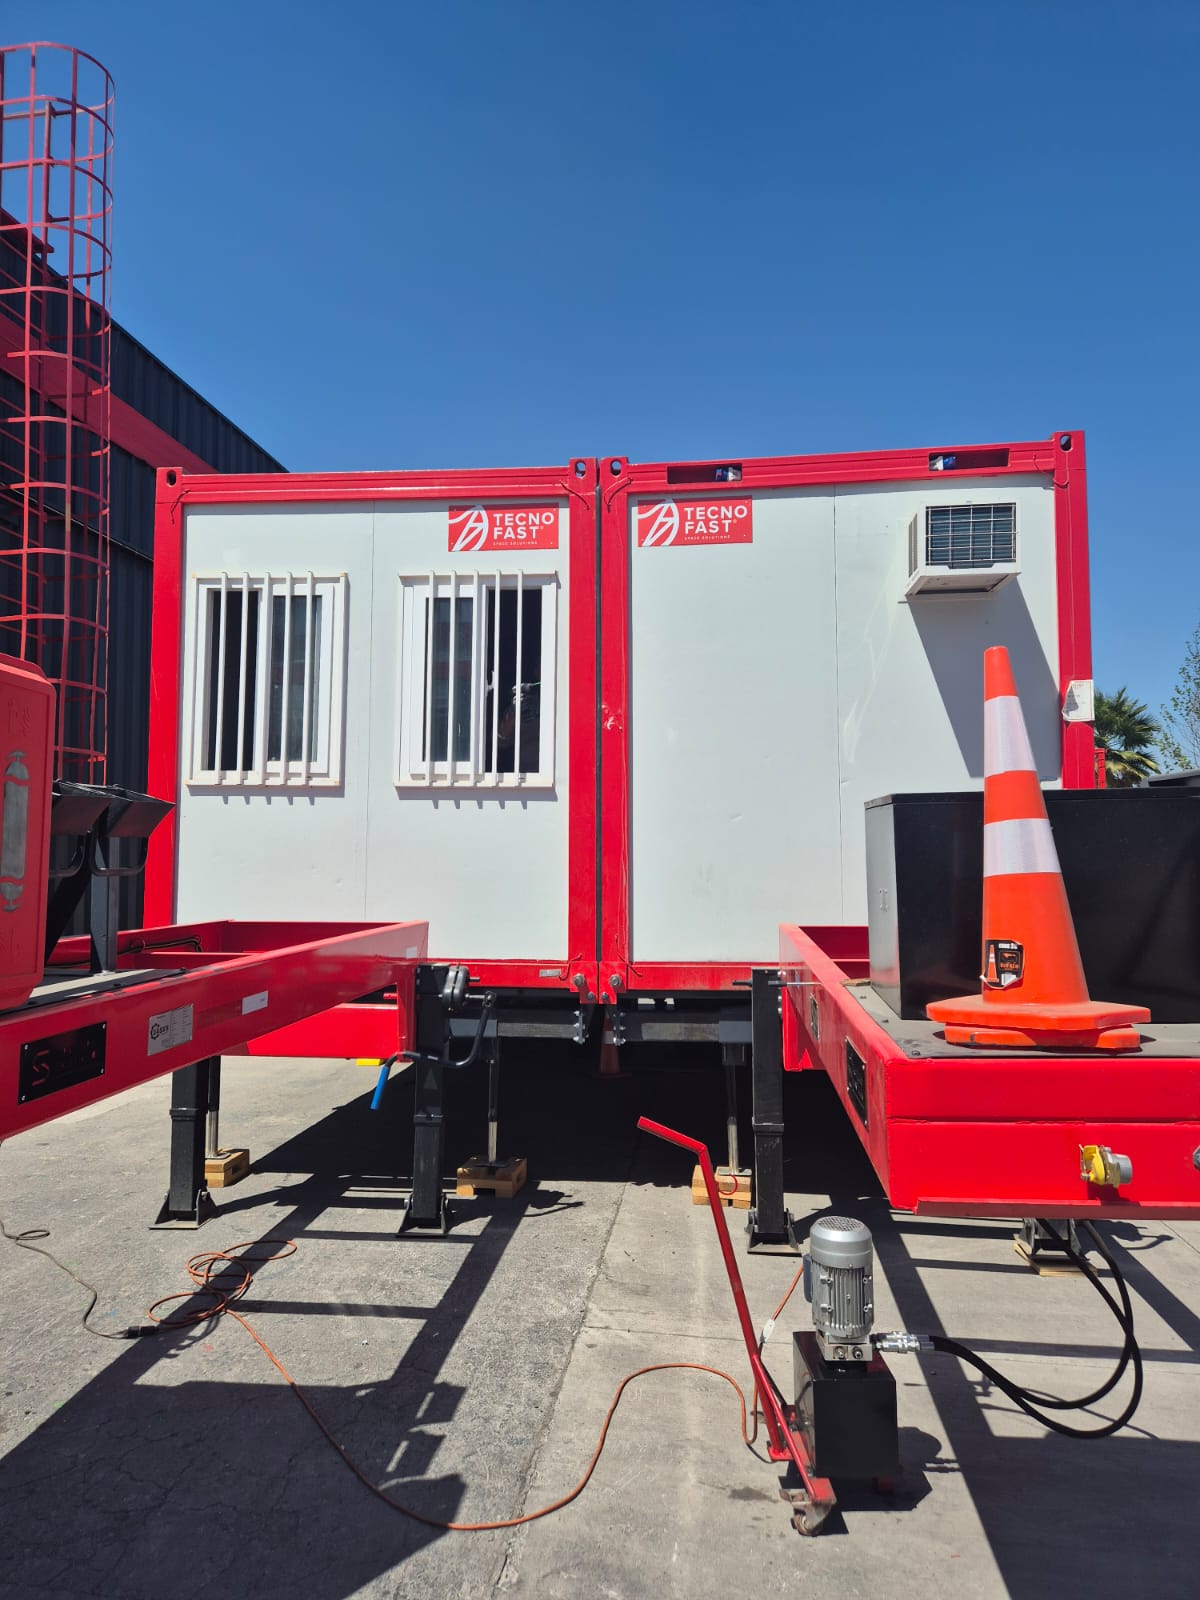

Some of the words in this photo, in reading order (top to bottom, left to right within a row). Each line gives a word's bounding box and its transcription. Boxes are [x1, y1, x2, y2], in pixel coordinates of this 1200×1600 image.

[493, 511, 555, 526] TECNO
[683, 504, 748, 520] TECNO
[493, 525, 540, 540] FAST
[684, 519, 732, 535] FAST
